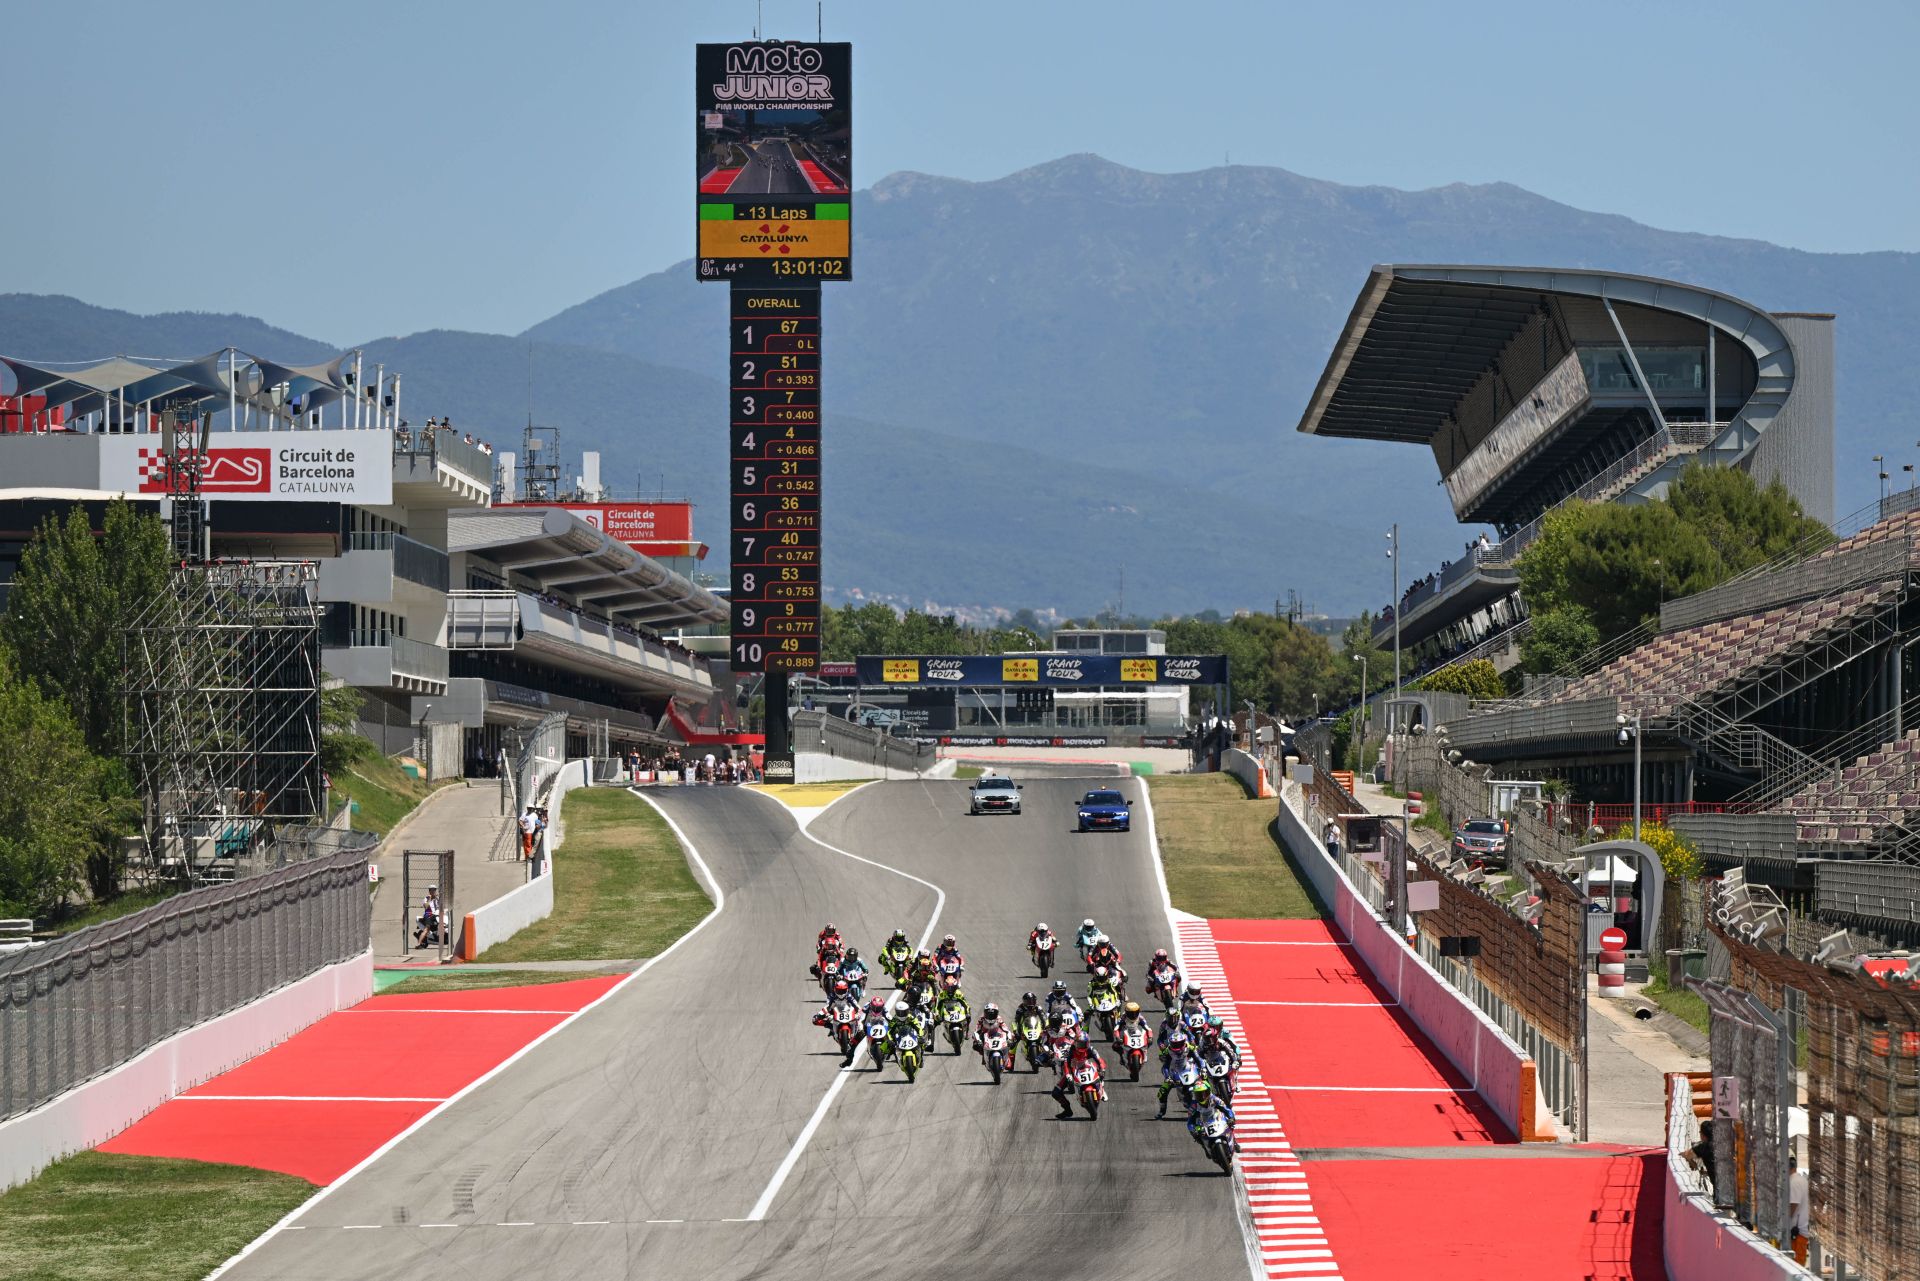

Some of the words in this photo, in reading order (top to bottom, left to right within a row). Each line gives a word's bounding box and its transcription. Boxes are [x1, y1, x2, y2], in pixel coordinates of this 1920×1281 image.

[727, 45, 822, 73] Moto
[713, 75, 834, 100] JUNIOR
[749, 206, 767, 219] 13
[771, 206, 808, 220] Laps
[772, 260, 843, 274] 13:01:02
[747, 298, 800, 308] OVERALL
[781, 320, 798, 333] 67
[743, 326, 753, 344] 1
[797, 340, 804, 348] 0
[808, 340, 814, 348] L
[781, 356, 797, 368] 51
[742, 362, 755, 379] 2
[786, 376, 814, 384] 0.393
[785, 391, 795, 403] 7
[743, 397, 755, 415] 3
[786, 411, 814, 419] 0.400
[785, 427, 795, 438] 4
[742, 432, 755, 450] 4
[279, 448, 332, 462] Circuit
[335, 449, 355, 462] de
[786, 446, 814, 454] 0.466
[279, 465, 355, 478] Barcelona
[781, 462, 797, 474] 31
[743, 467, 755, 485] 5
[279, 482, 355, 493] CATALUNYA
[786, 481, 814, 490] 0.542
[781, 497, 798, 509] 36
[608, 509, 641, 519] Circuit
[642, 510, 655, 519] de
[743, 503, 755, 521] 6
[608, 520, 655, 528] Barcelona
[786, 517, 813, 525] 0.711
[781, 533, 798, 544] 40
[743, 538, 755, 556] 7
[786, 552, 814, 560] 0.747
[781, 568, 798, 580] 53
[743, 573, 755, 591] 8
[786, 587, 814, 596] 0.753
[785, 604, 794, 615] 9
[743, 609, 755, 627] 9
[786, 622, 814, 631] 0.777
[781, 639, 798, 651] 49
[737, 644, 761, 662] 10
[786, 658, 814, 667] 0.889
[926, 659, 963, 669] GRAND
[1046, 659, 1082, 668] GRAND
[1164, 659, 1200, 669] GRAND
[931, 670, 958, 679] TOUR
[1050, 670, 1077, 678] TOUR
[1168, 670, 1195, 678] TOUR
[901, 1039, 914, 1048] 49
[1215, 1065, 1223, 1074] 4
[1081, 1073, 1091, 1082] 51
